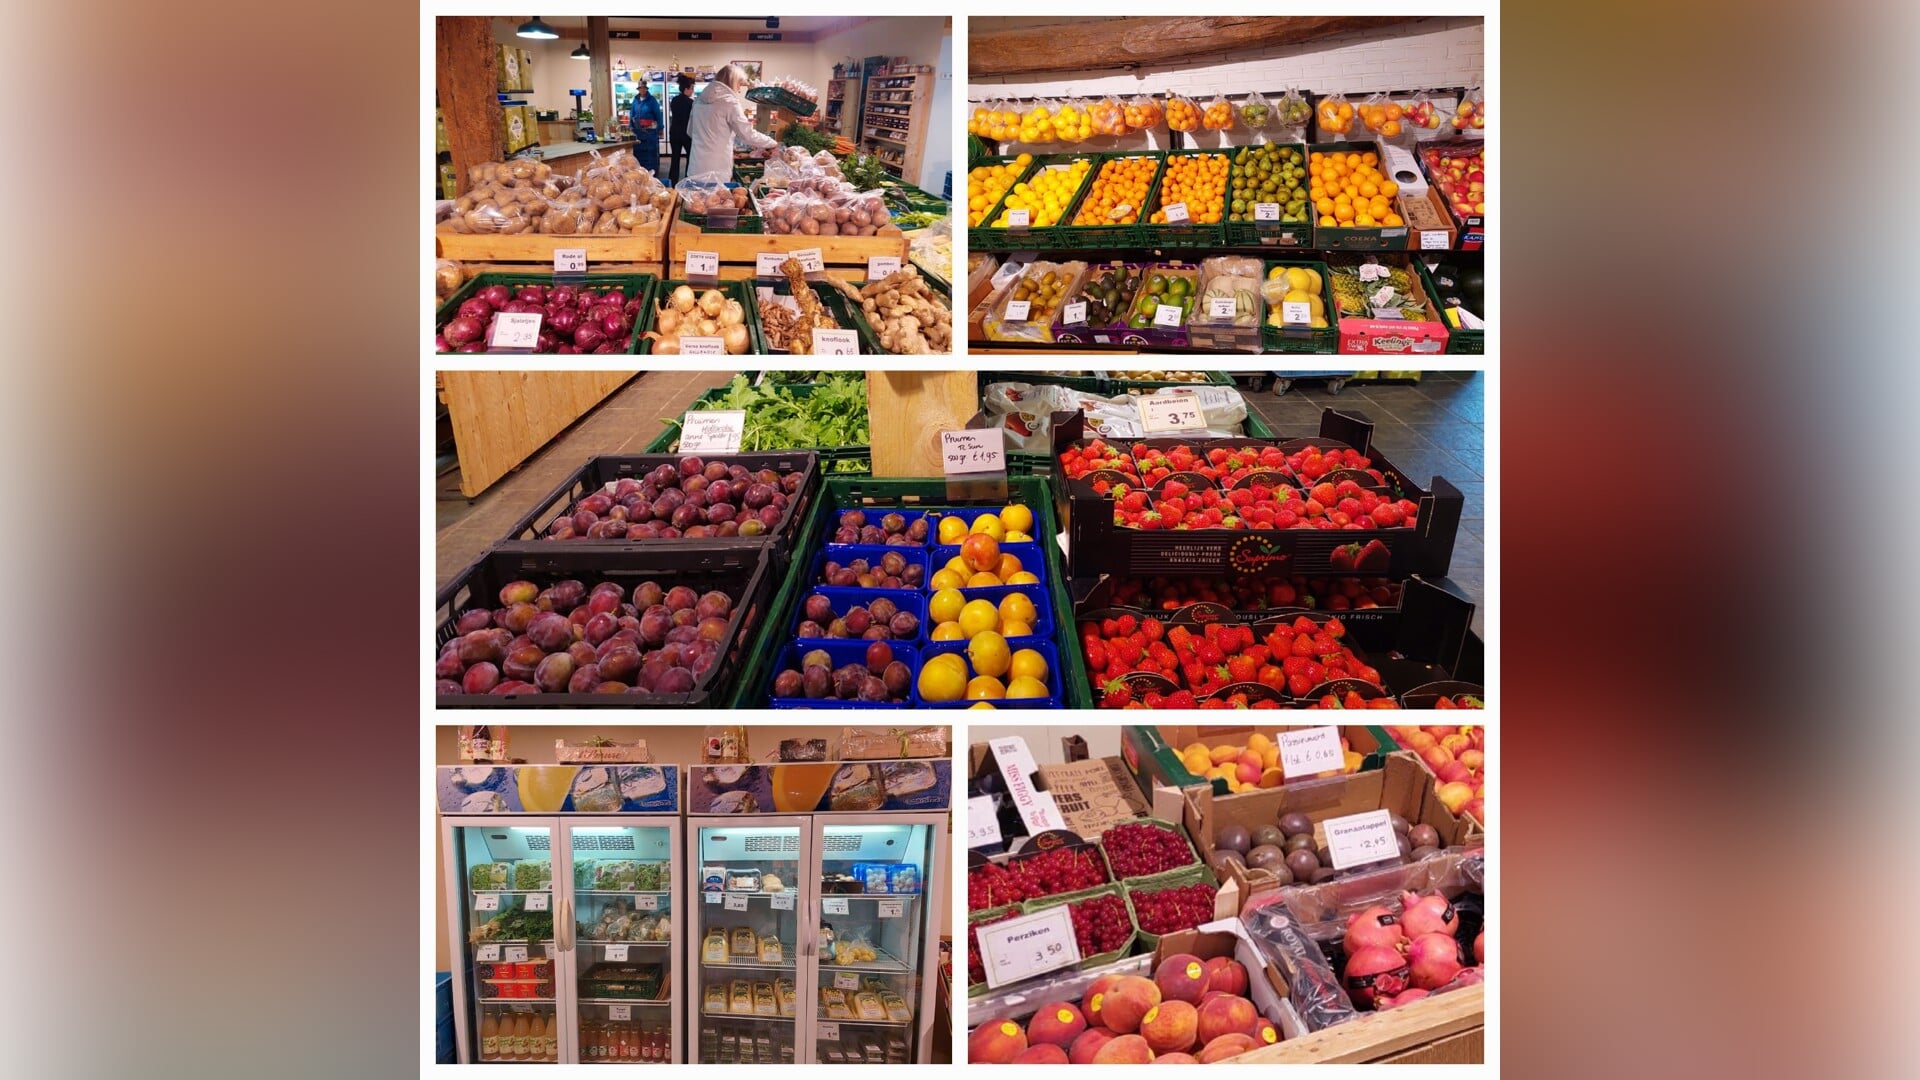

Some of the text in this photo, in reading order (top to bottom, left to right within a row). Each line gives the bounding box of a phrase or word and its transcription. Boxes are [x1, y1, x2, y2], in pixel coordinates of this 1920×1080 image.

[1374, 338, 1413, 347] Keelings
[1149, 398, 1189, 406] Aardbeien
[945, 434, 976, 444] Pruimen
[1006, 763, 1034, 808] MISS FIGGY
[1334, 820, 1387, 836] Granaatappel
[1007, 926, 1051, 944] Perziken
